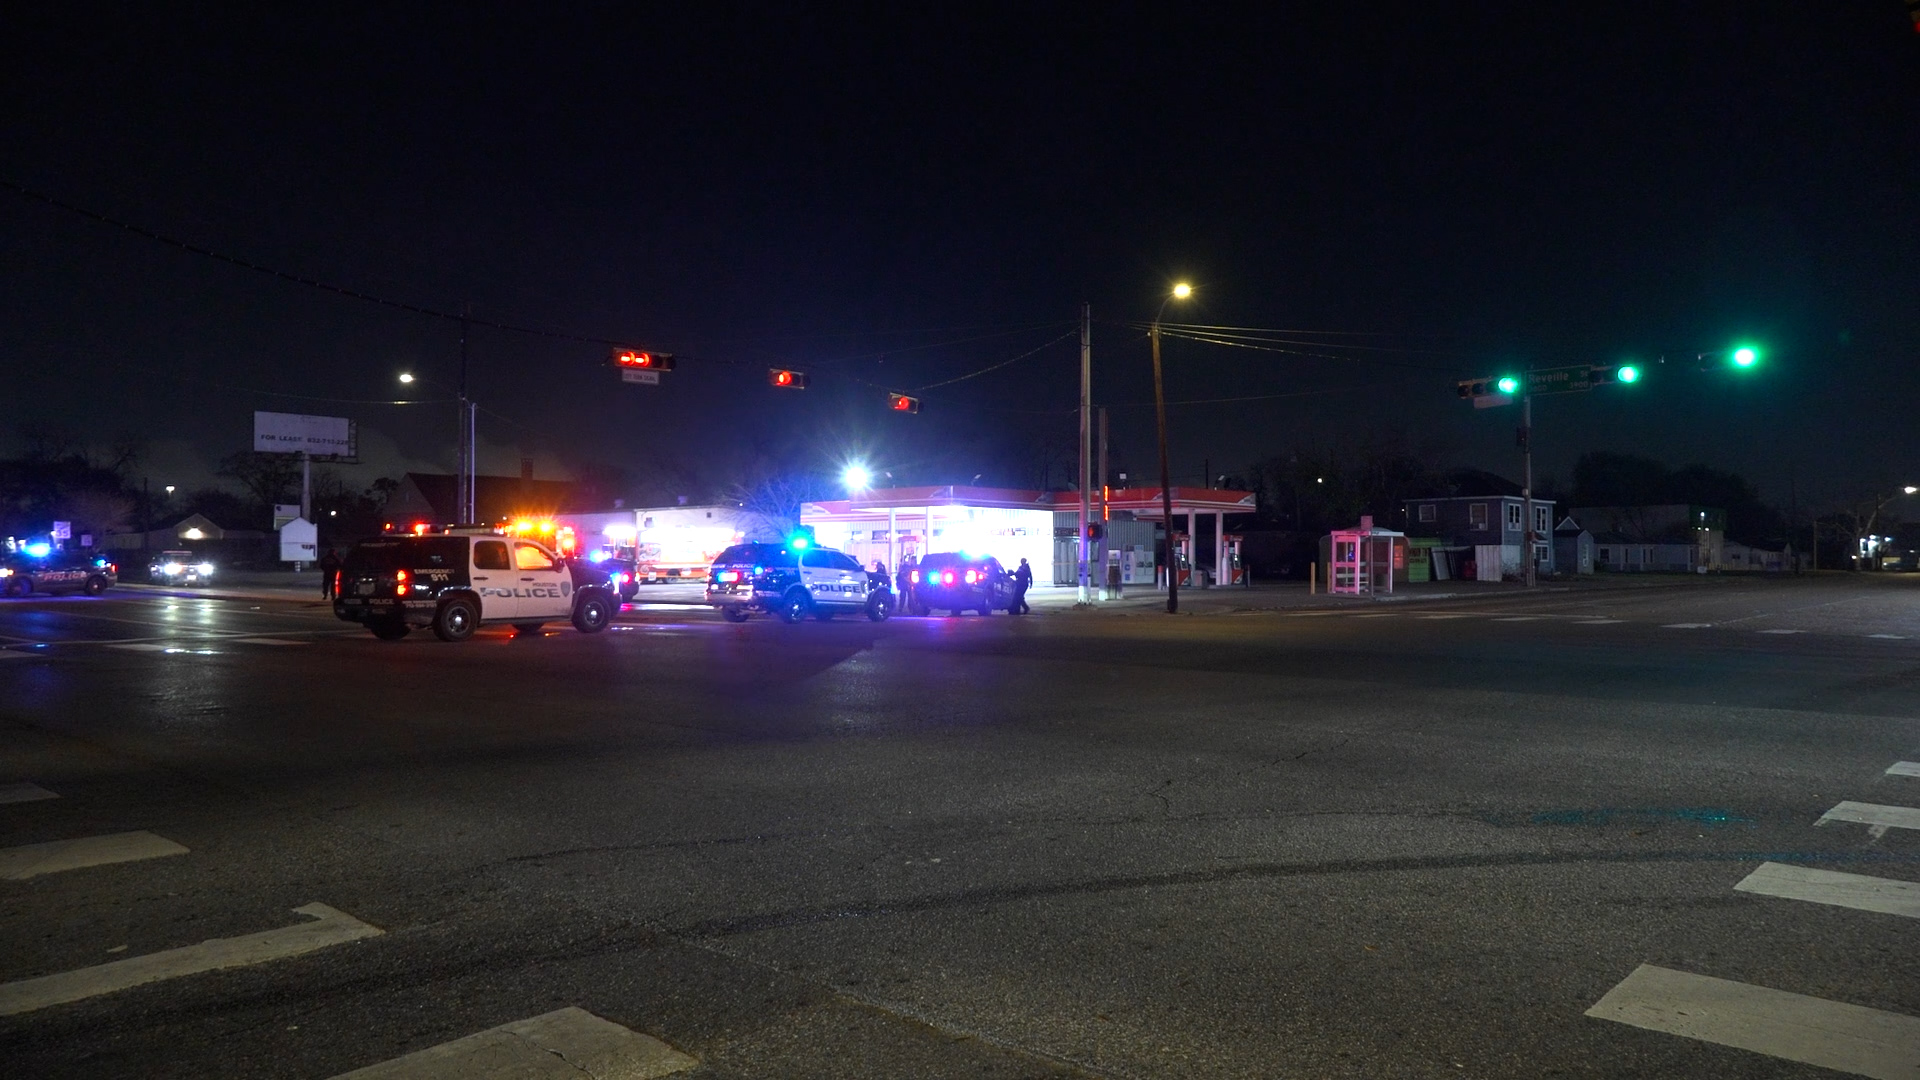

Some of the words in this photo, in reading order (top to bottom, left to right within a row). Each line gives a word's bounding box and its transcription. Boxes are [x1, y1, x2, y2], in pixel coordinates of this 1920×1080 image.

[1528, 371, 1569, 383] Reveille
[44, 571, 88, 581] POLICE
[430, 573, 449, 582] 911
[480, 587, 560, 598] POLICE
[811, 583, 861, 594] POLICE
